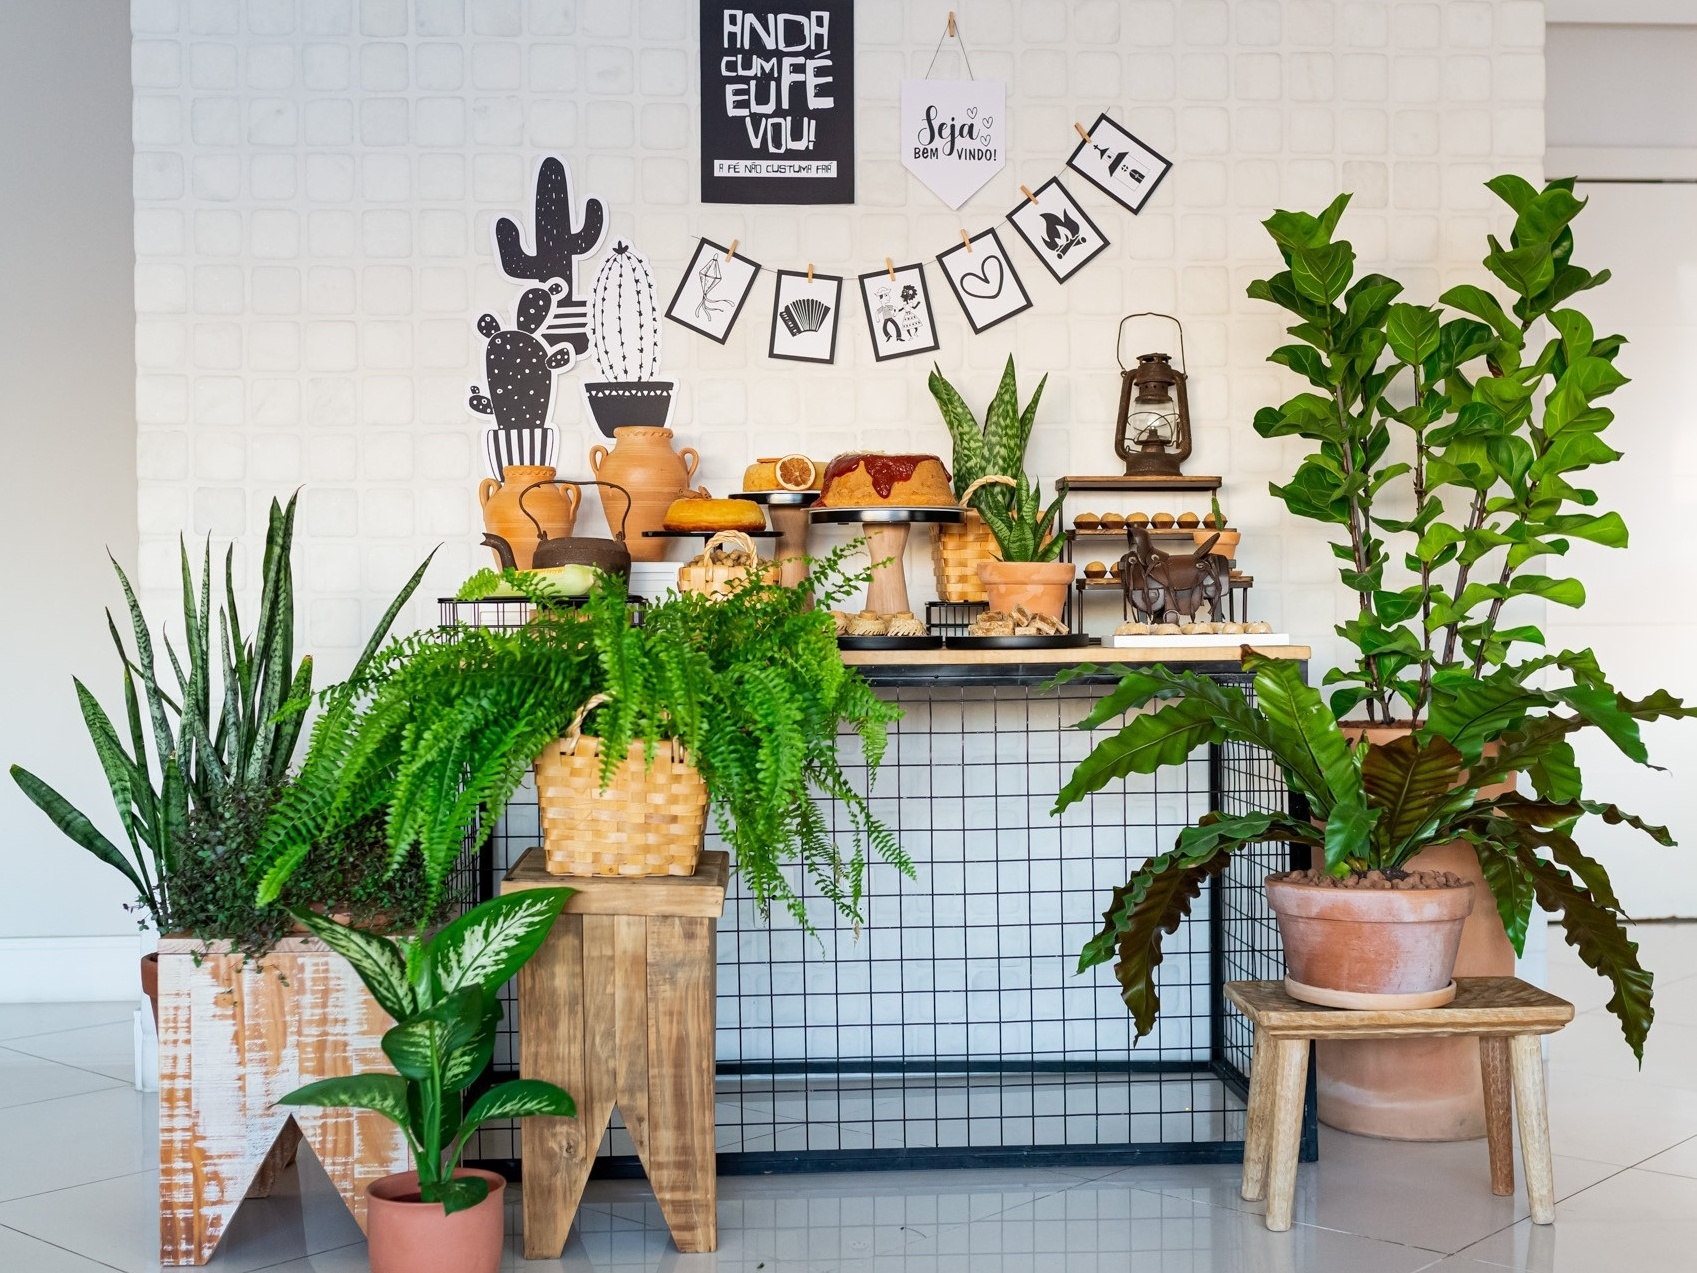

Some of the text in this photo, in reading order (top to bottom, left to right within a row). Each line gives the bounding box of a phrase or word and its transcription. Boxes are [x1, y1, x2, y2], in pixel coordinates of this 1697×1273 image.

[724, 10, 830, 51] ANDA
[721, 51, 834, 109] CUM FÉ
[725, 79, 777, 117] EU
[745, 116, 816, 153] VOU!
[918, 105, 980, 156] Seja
[719, 163, 724, 173] A
[727, 162, 741, 174] FÉ
[744, 162, 762, 174] NÃO
[766, 164, 812, 173] CUSTUMA
[956, 148, 998, 161] VINDO!
